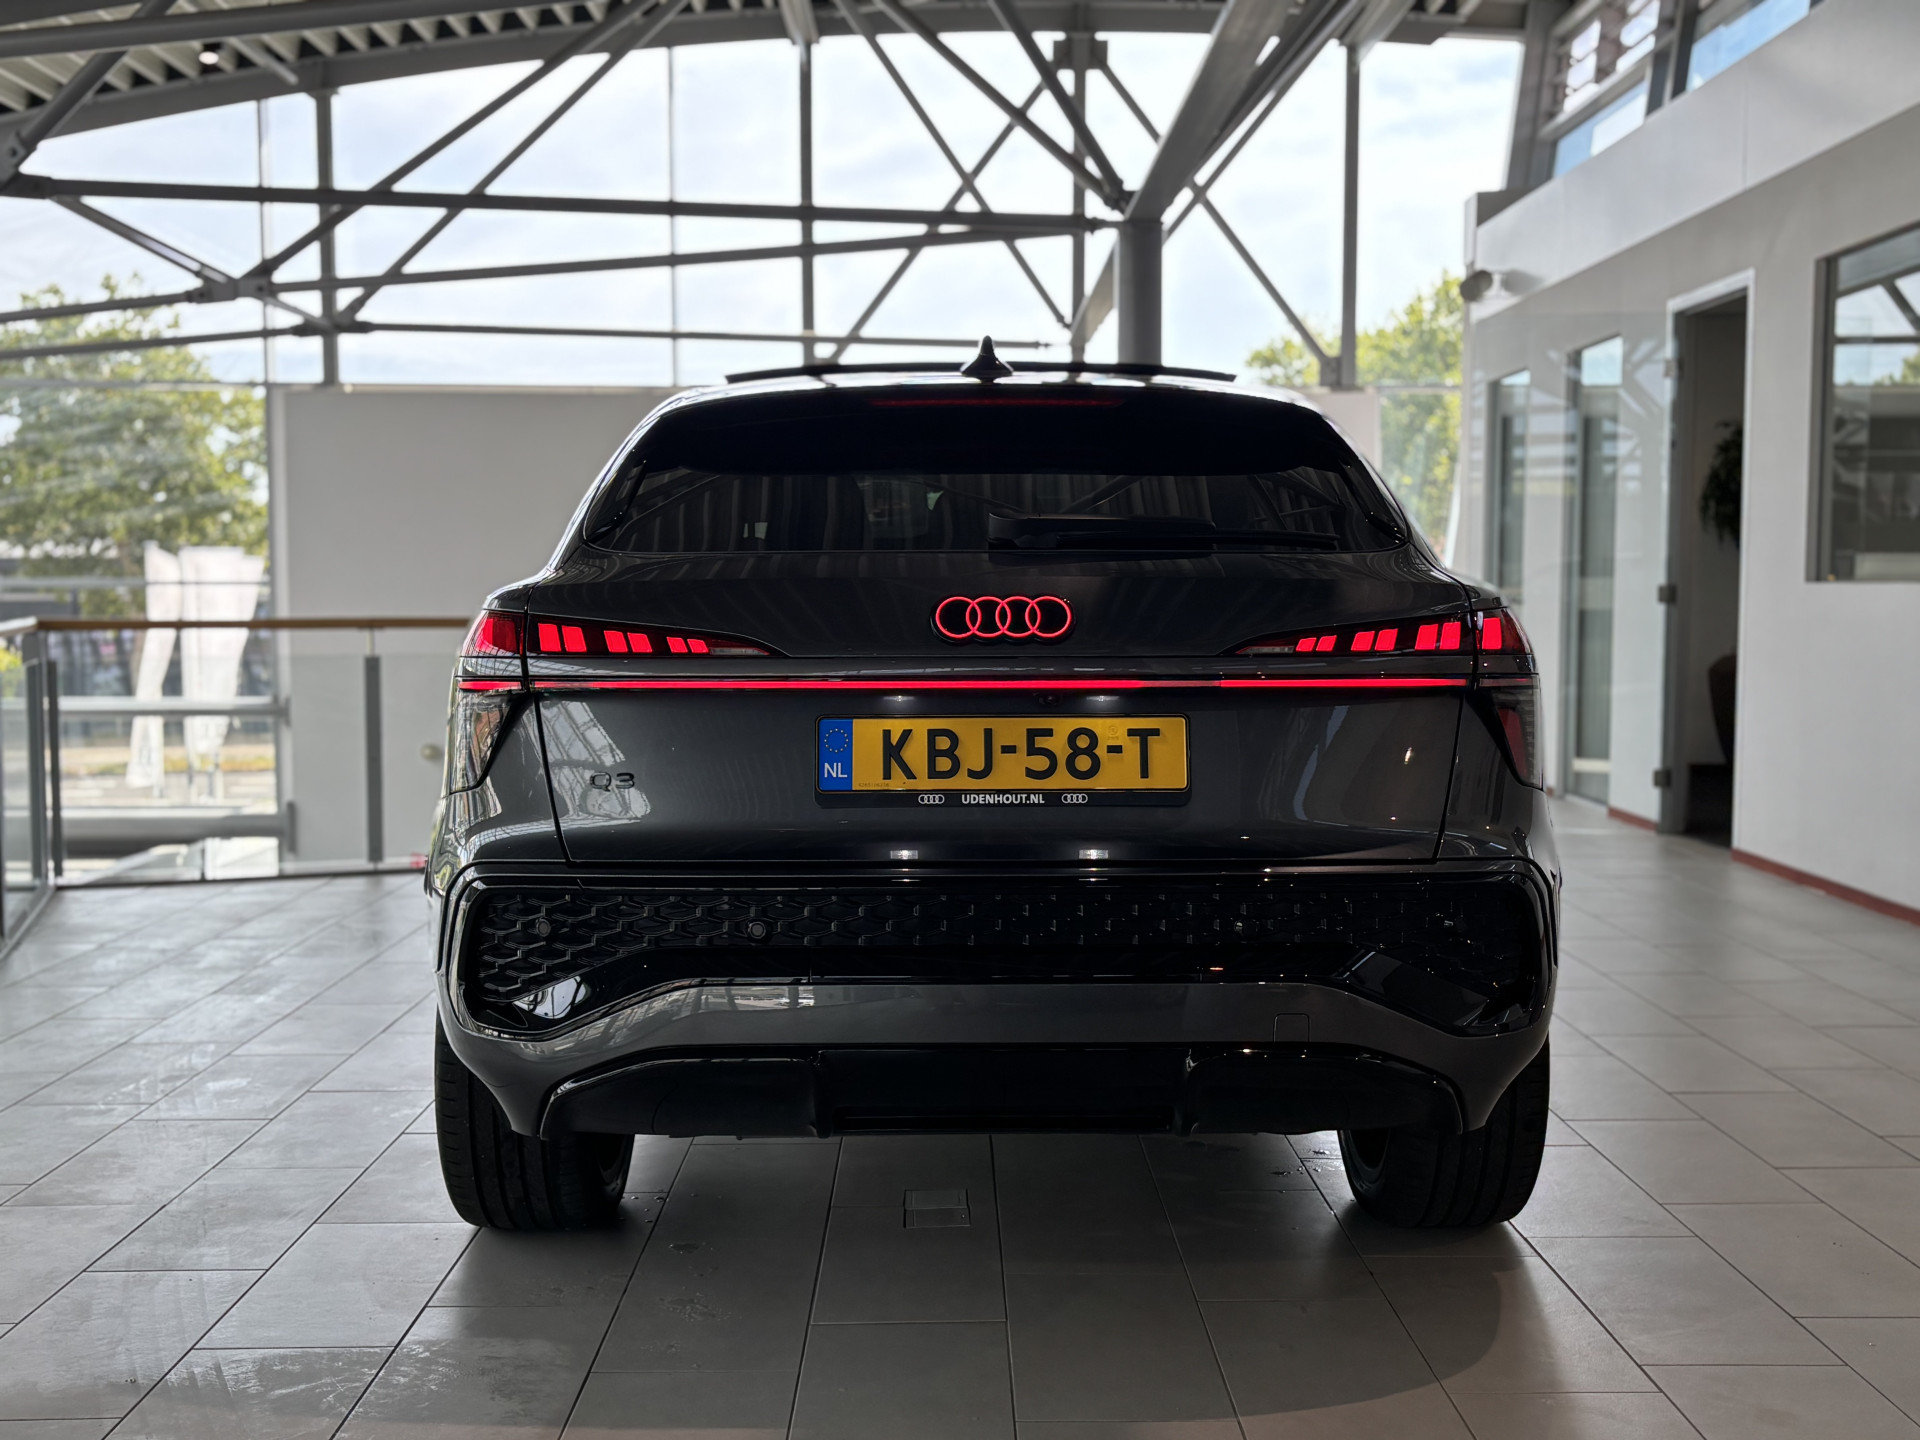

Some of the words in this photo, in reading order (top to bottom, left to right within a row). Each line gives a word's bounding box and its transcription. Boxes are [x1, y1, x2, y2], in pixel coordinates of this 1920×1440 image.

[882, 728, 1161, 781] KBJ-58-T
[824, 763, 848, 778] NL
[590, 772, 635, 792] Q3
[961, 794, 1045, 804] UDENHOUT.NL
